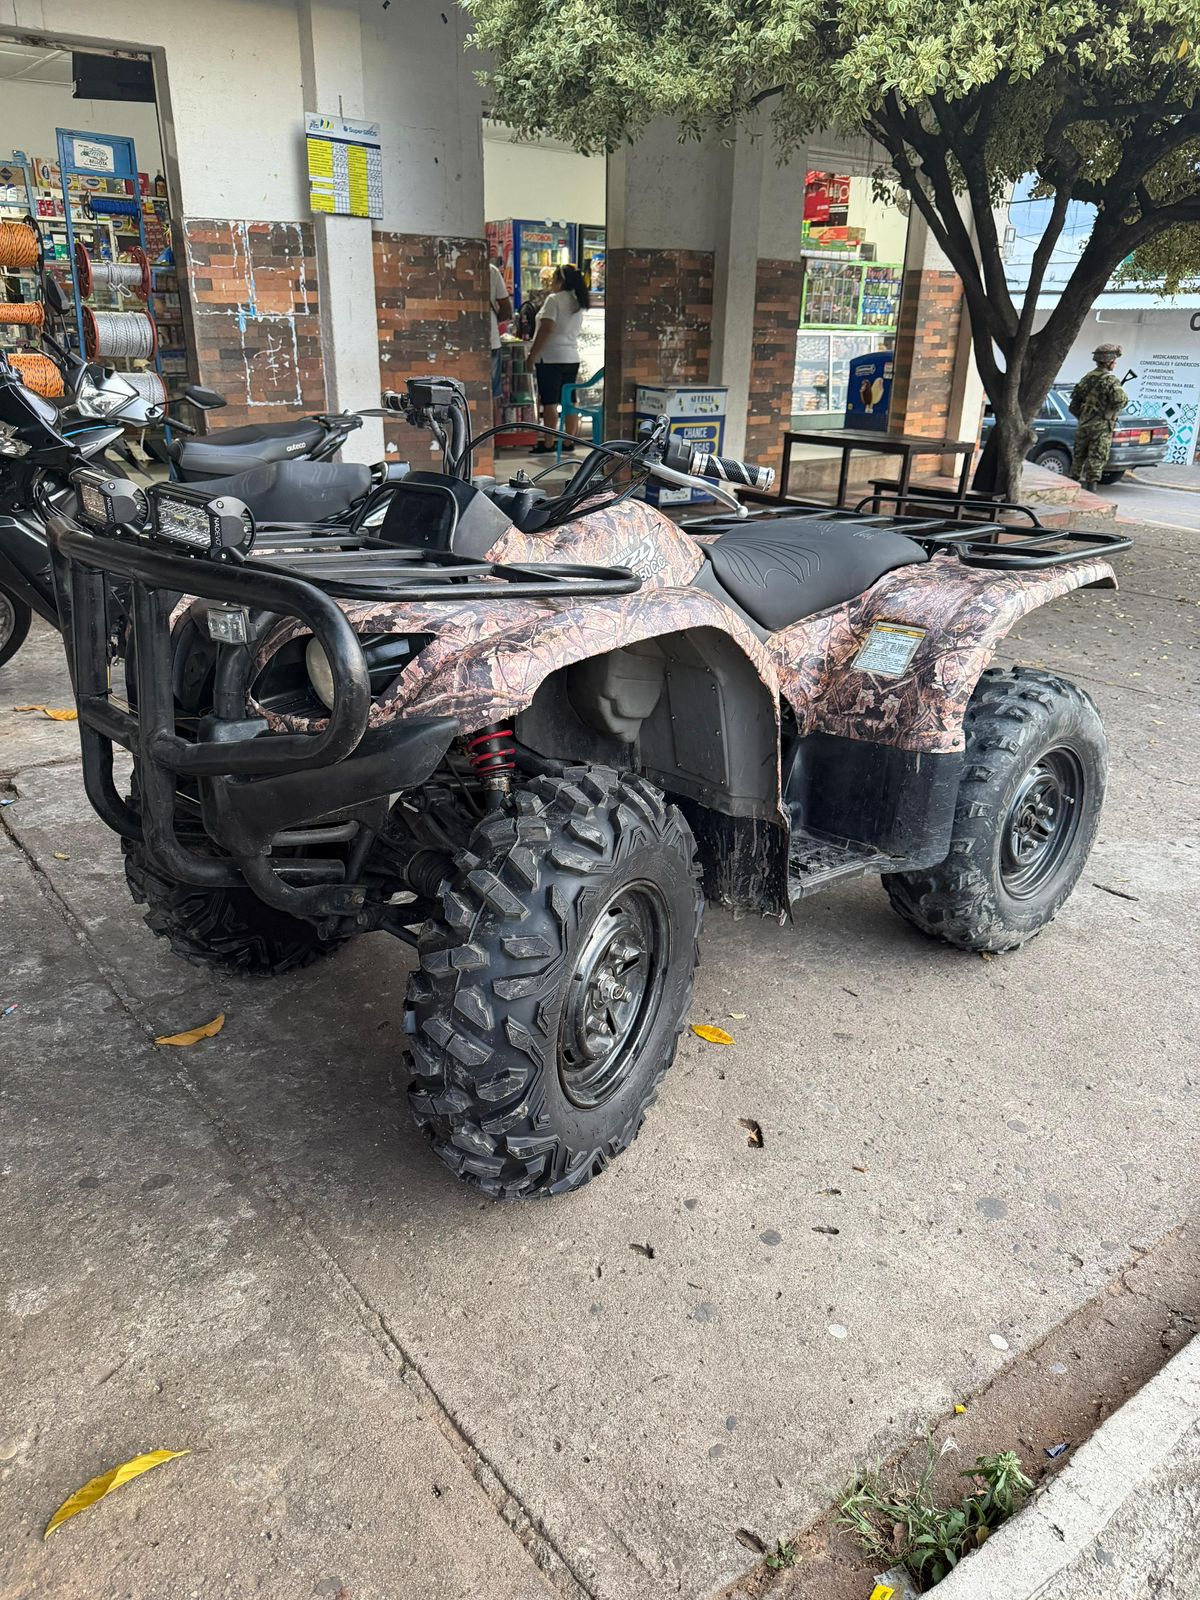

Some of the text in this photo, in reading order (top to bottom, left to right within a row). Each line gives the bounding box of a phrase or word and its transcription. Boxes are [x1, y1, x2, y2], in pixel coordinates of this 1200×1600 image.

[684, 427, 708, 438] CHANCE
[286, 441, 306, 452] auteco
[213, 516, 222, 546] NAOEVO
[609, 546, 633, 566] YAMAHA
